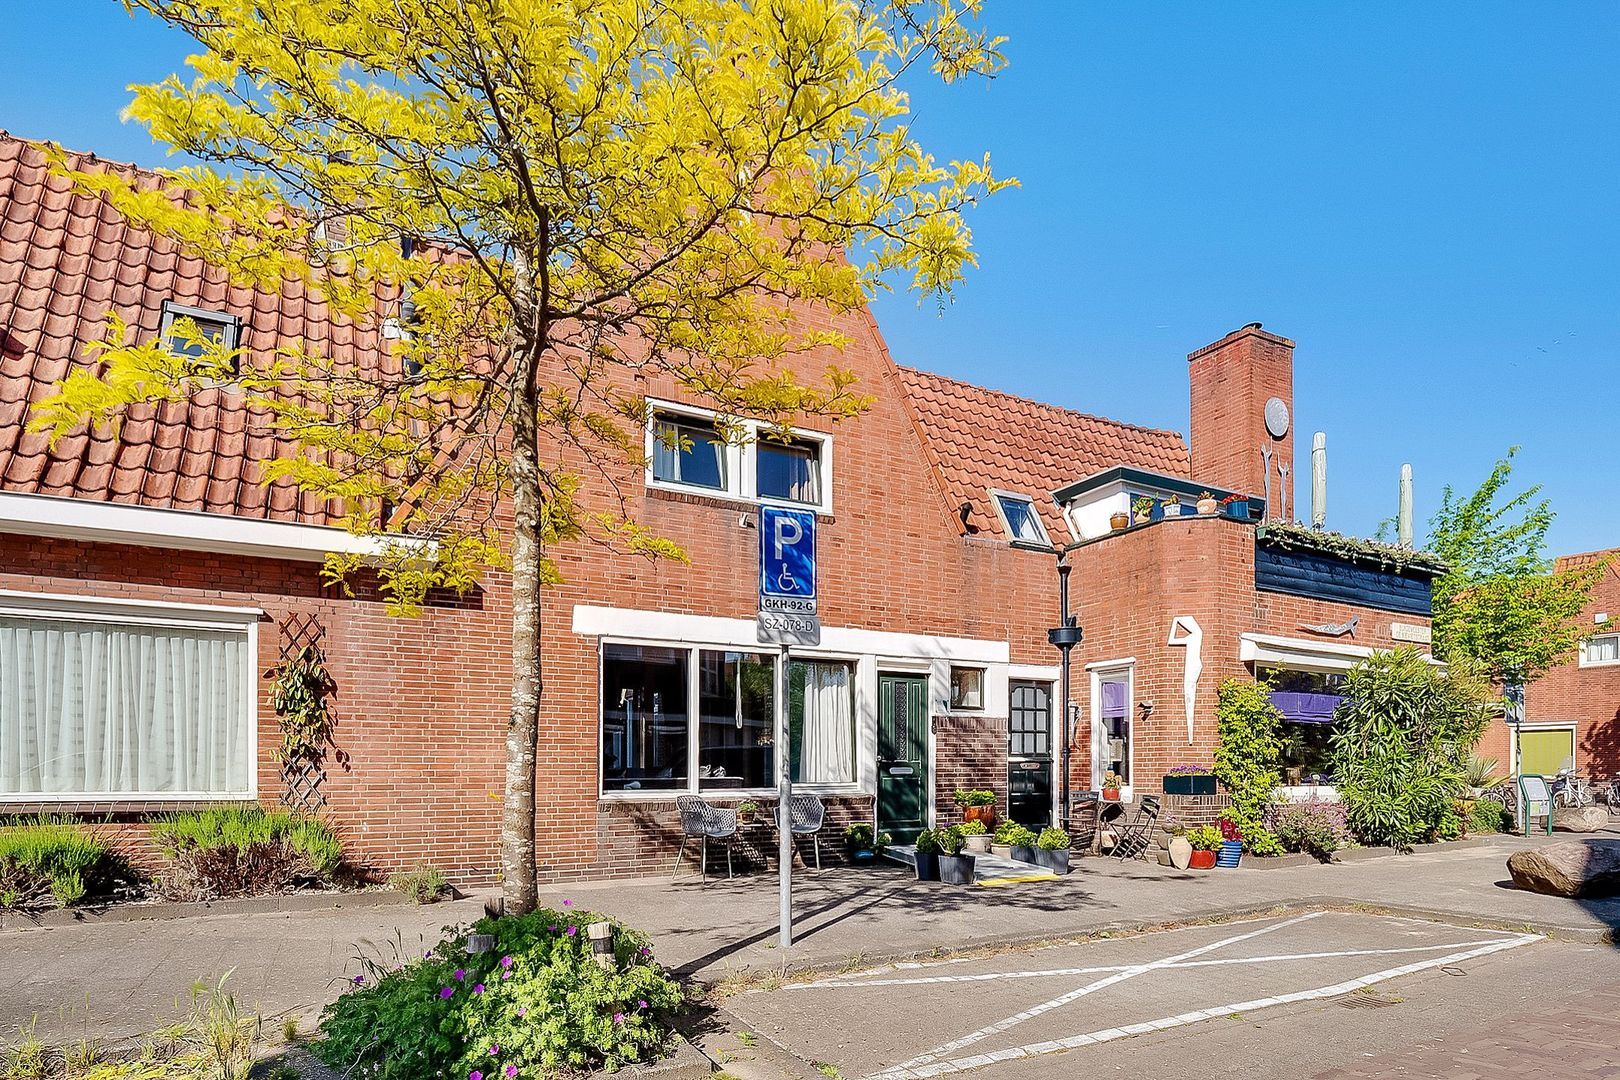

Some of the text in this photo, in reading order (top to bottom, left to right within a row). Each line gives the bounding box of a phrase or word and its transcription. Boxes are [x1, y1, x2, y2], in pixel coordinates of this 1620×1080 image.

[775, 516, 803, 560] P
[764, 599, 813, 611] GKH-92-G
[764, 618, 813, 632] SZ-078-D
